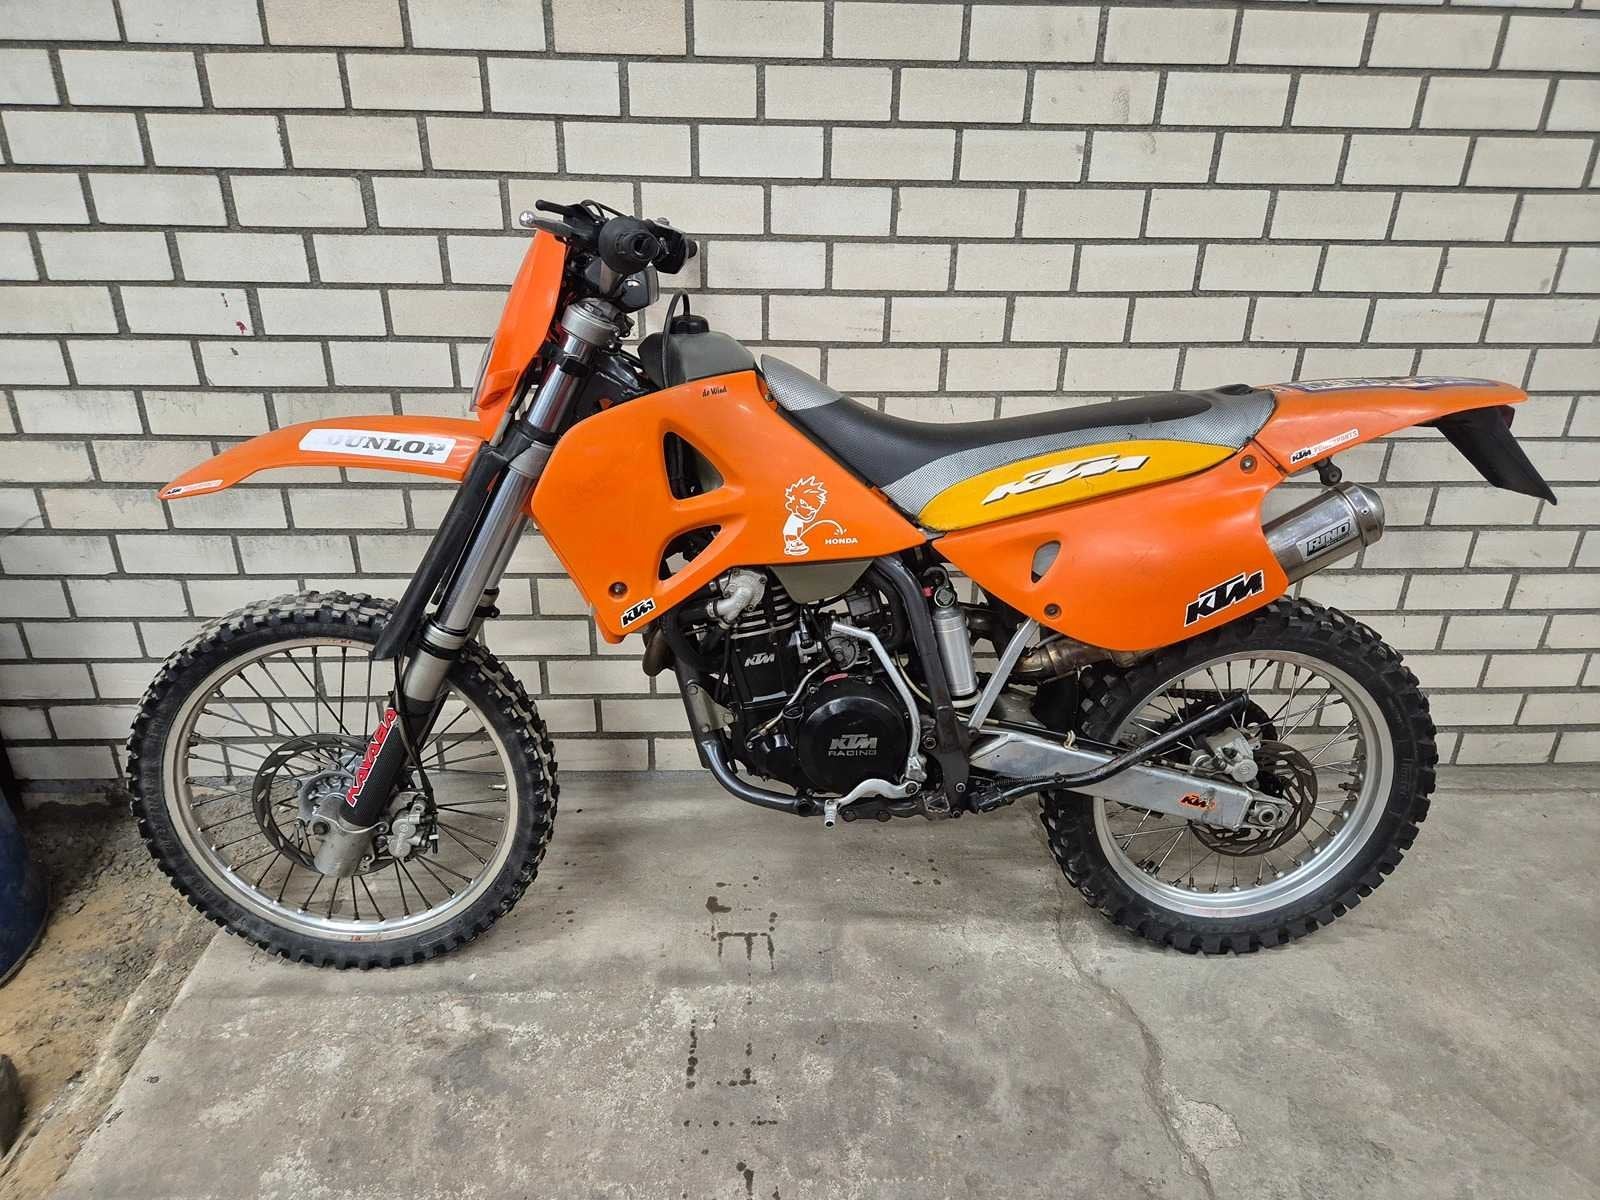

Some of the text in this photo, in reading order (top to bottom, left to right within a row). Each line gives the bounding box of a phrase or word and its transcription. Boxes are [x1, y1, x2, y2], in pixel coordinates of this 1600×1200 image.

[1292, 449, 1311, 462] KTM
[825, 537, 858, 545] HONDA
[1184, 570, 1264, 626] KTM
[621, 599, 655, 626] KTM
[745, 652, 775, 667] KTM
[829, 734, 878, 750] KTM
